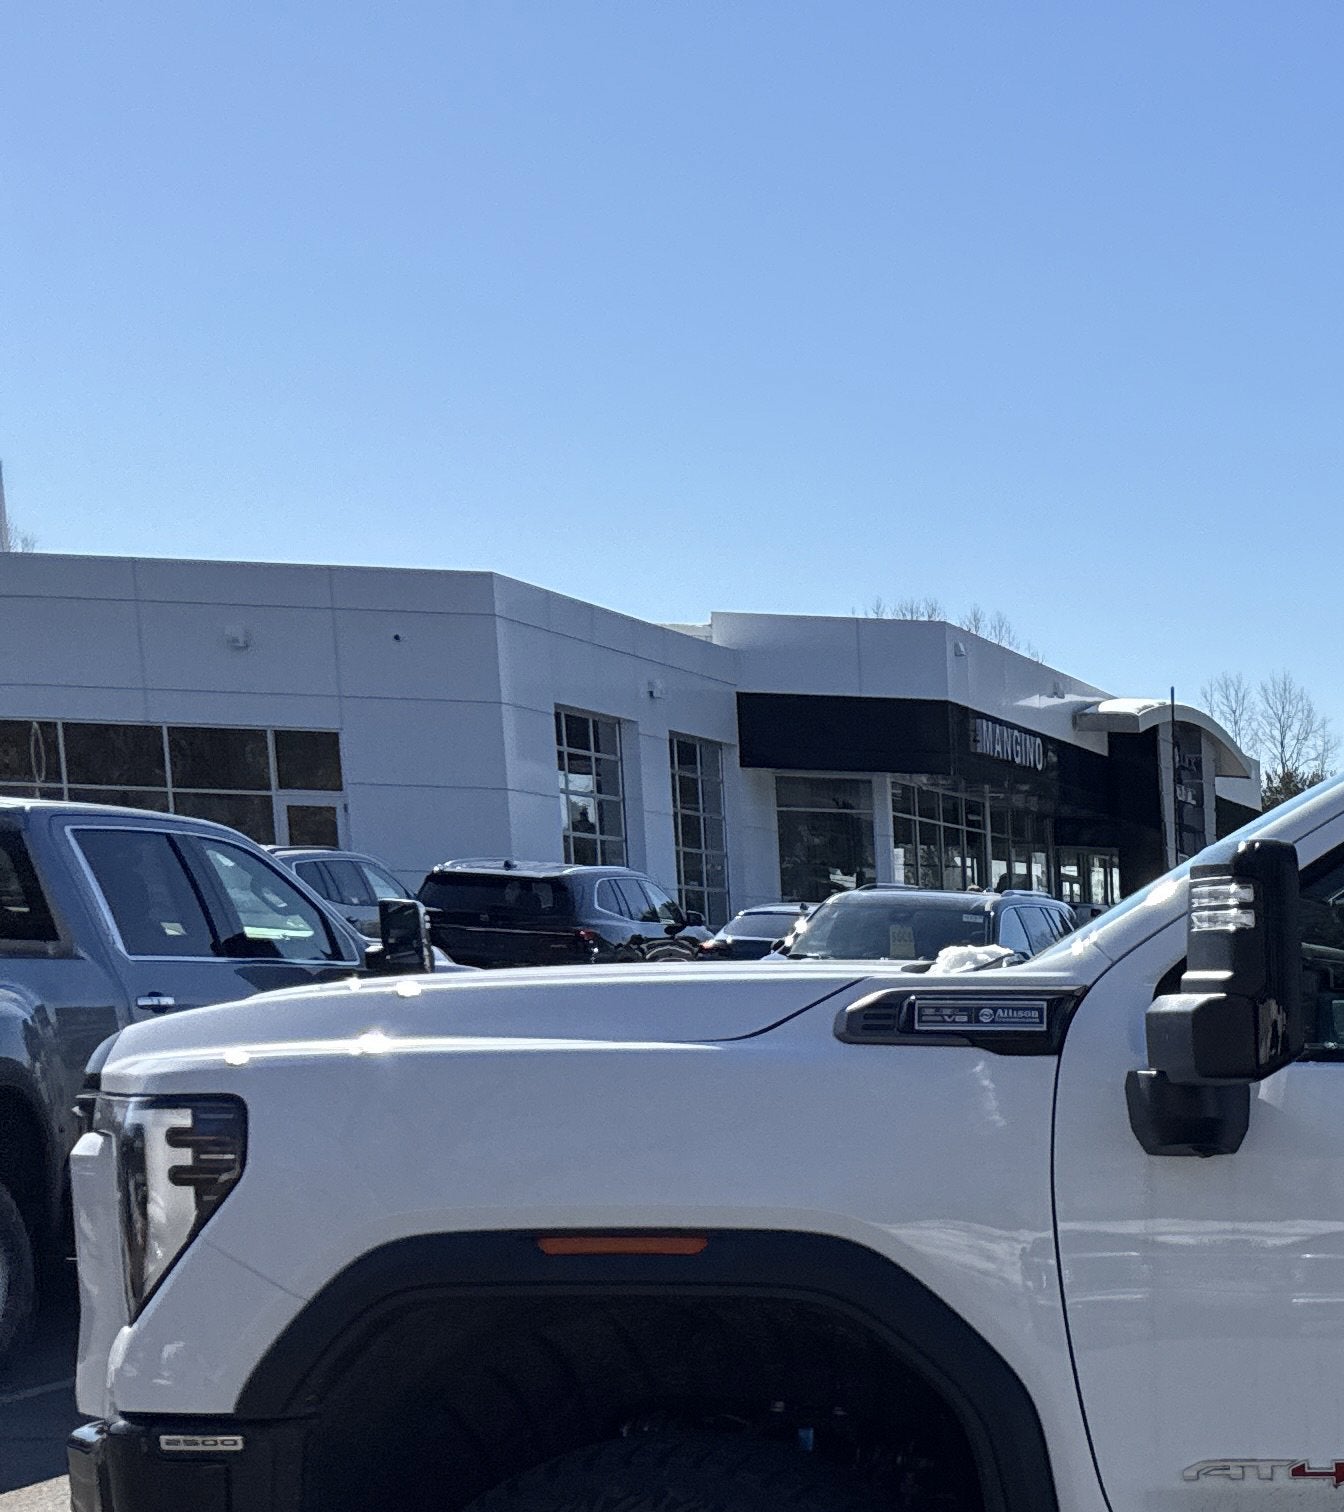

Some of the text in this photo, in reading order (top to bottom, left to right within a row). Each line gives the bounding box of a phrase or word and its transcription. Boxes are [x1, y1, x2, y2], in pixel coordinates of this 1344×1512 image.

[978, 719, 1043, 771] MANGINO
[995, 1008, 1039, 1019] Allison
[163, 1437, 239, 1448] 2500
